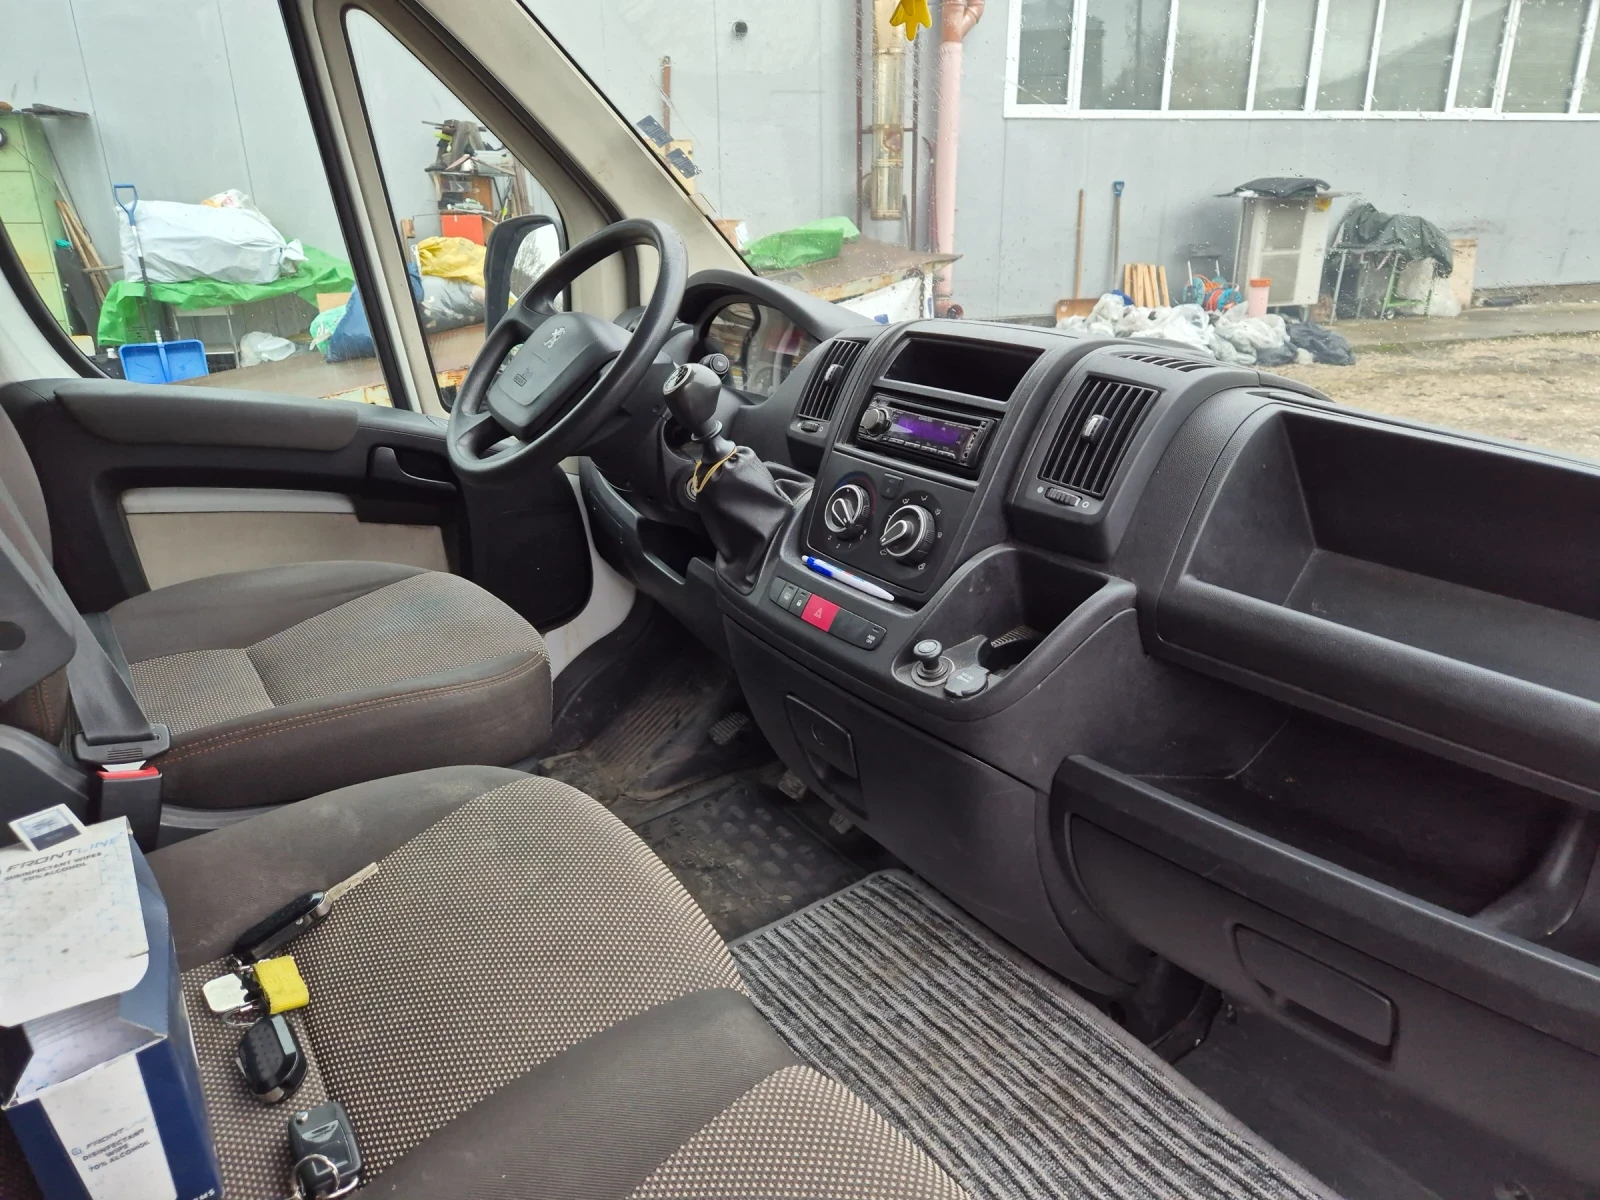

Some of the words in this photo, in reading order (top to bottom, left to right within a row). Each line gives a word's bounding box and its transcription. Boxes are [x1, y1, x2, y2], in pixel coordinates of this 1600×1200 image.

[74, 851, 102, 863] WIPES
[43, 862, 87, 877] ALCOHOL
[82, 1128, 145, 1161] DISINFECTANT
[88, 1161, 108, 1172] 70%
[109, 1140, 150, 1164] ALCOHOL
